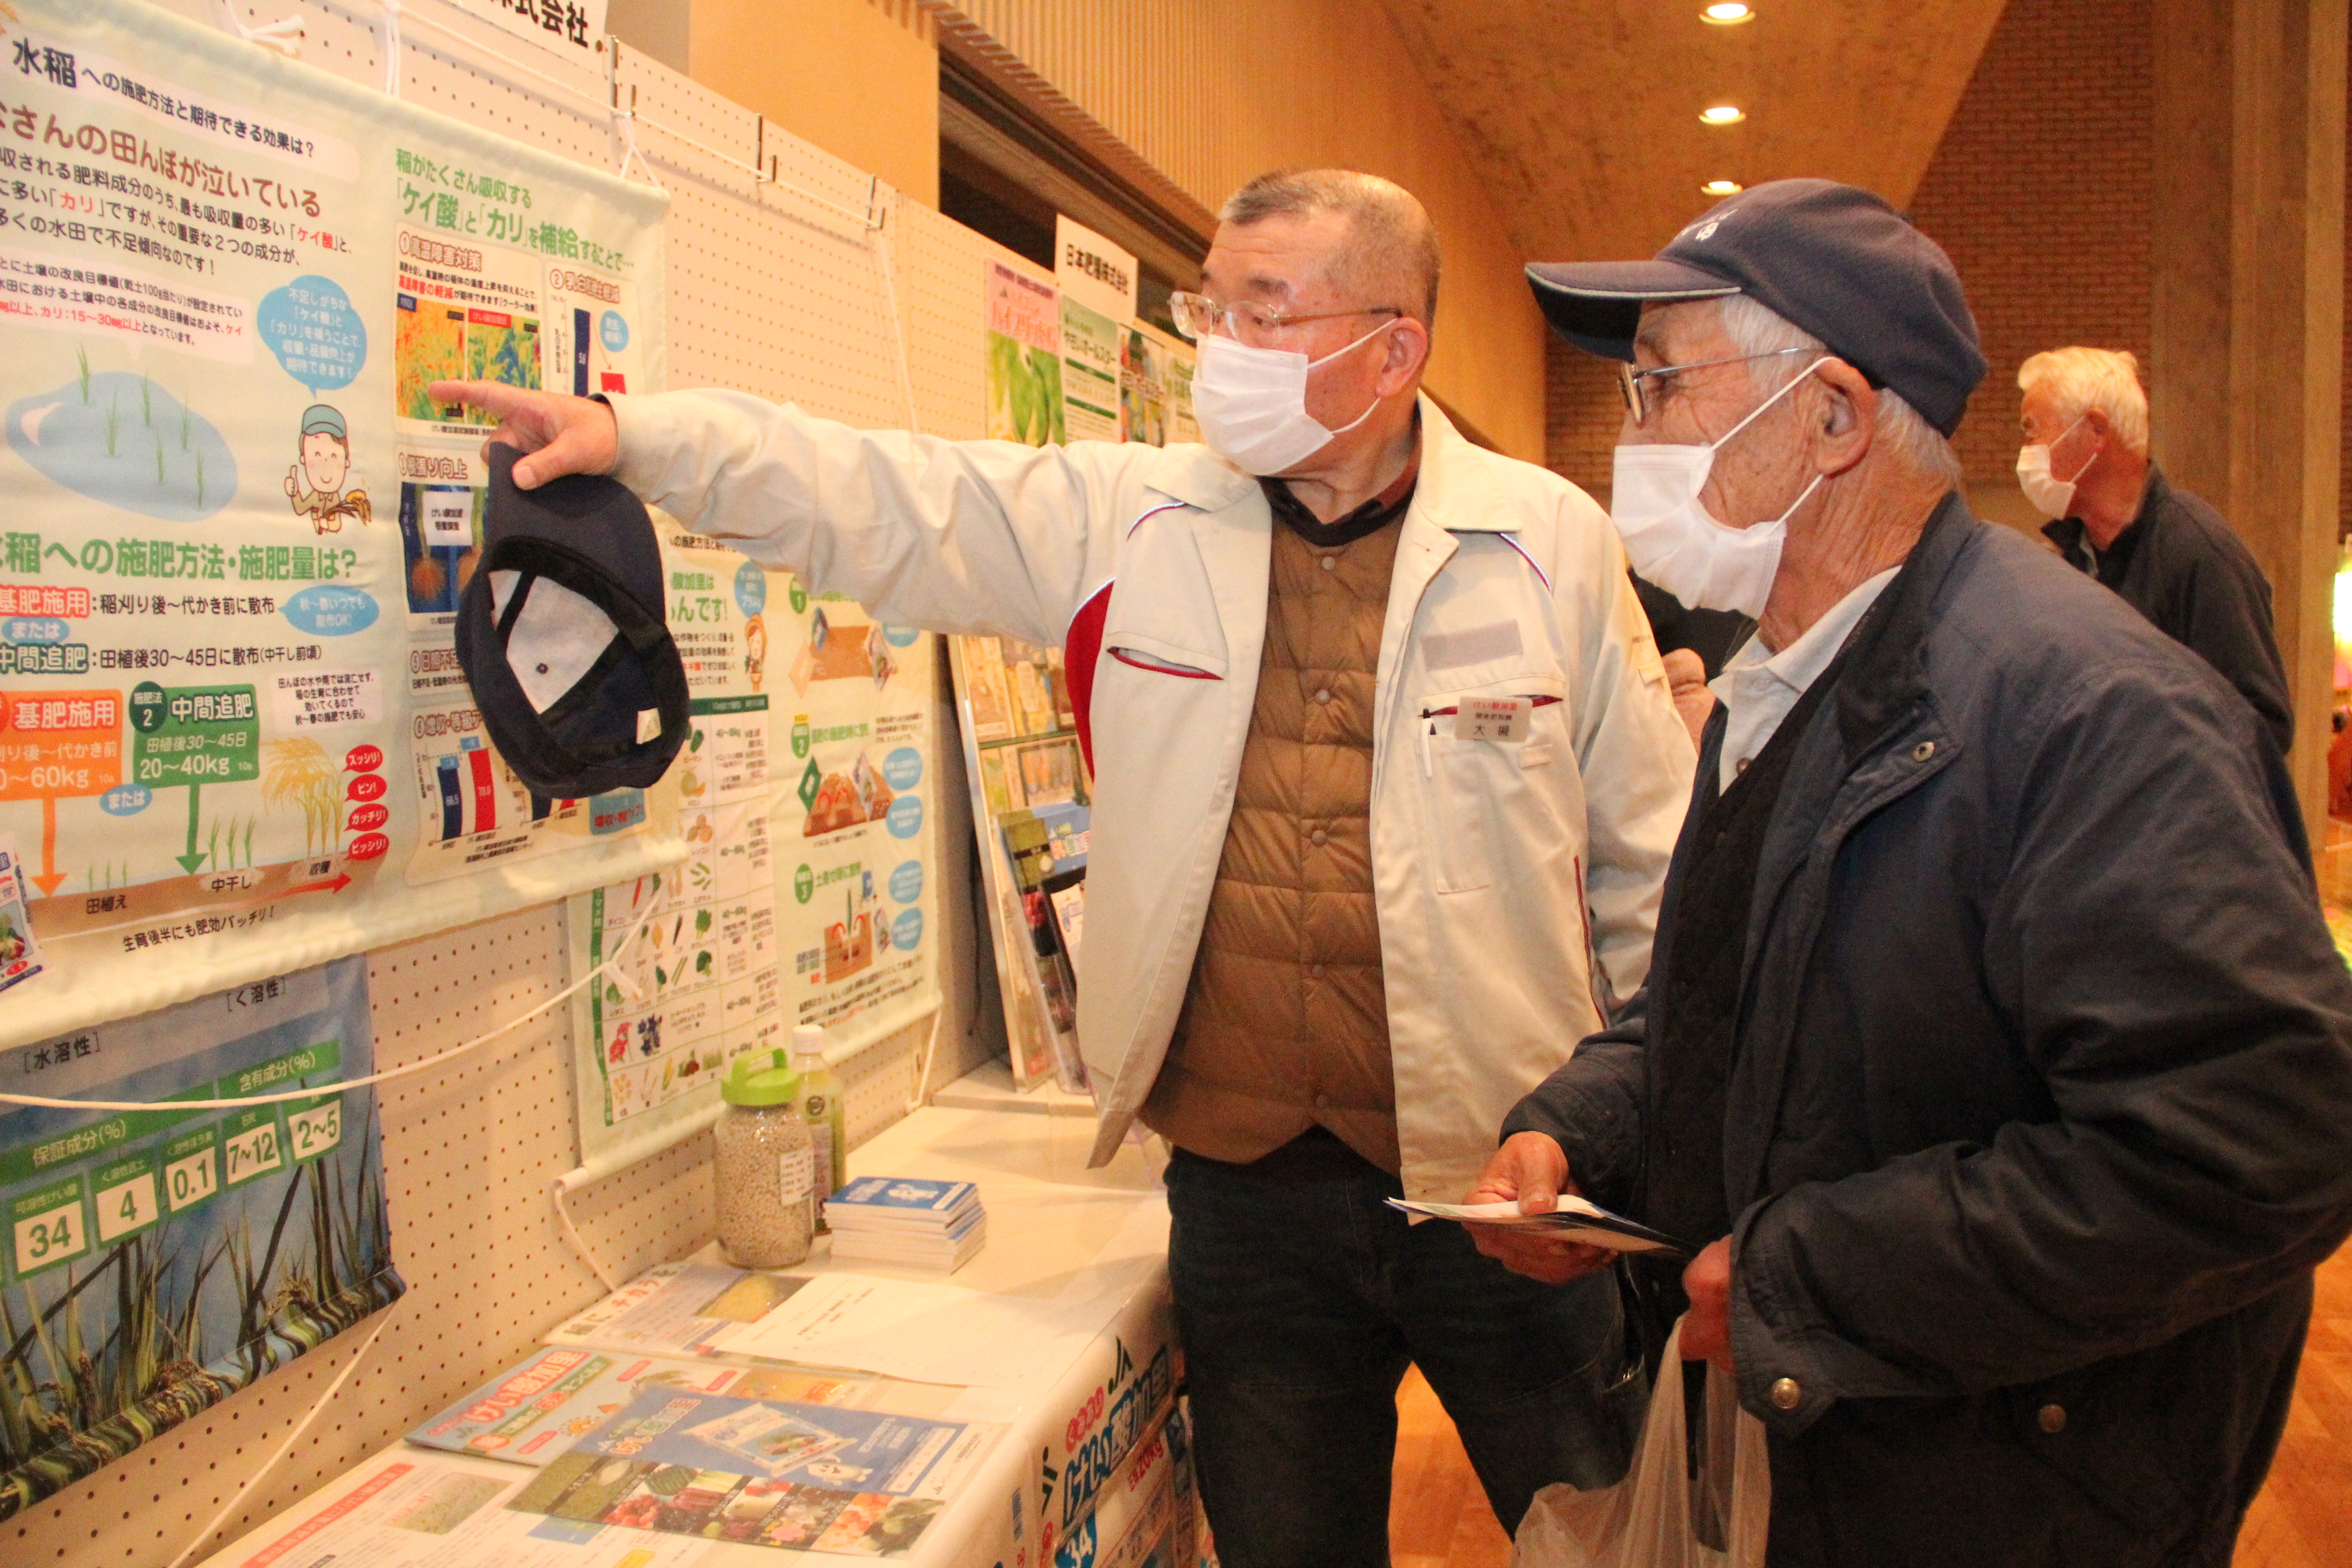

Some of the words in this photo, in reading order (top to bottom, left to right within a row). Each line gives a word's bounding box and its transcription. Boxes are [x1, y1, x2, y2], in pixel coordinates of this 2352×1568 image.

[0, 101, 321, 218] さんの田んぼが泣いている
[395, 147, 532, 209] 稲がたくさん吸収する
[0, 532, 357, 580] 稲への施肥方法・施肥量は？
[12, 621, 61, 639] または
[14, 700, 116, 729] 基肥施用
[143, 708, 152, 726] 2
[172, 693, 254, 722] 中間追肥
[108, 790, 146, 809] または
[212, 874, 252, 892] 中干し
[86, 894, 127, 915] 田植え
[174, 1158, 209, 1200] 0.1
[120, 1190, 137, 1221] 4
[29, 1215, 71, 1258] 34
